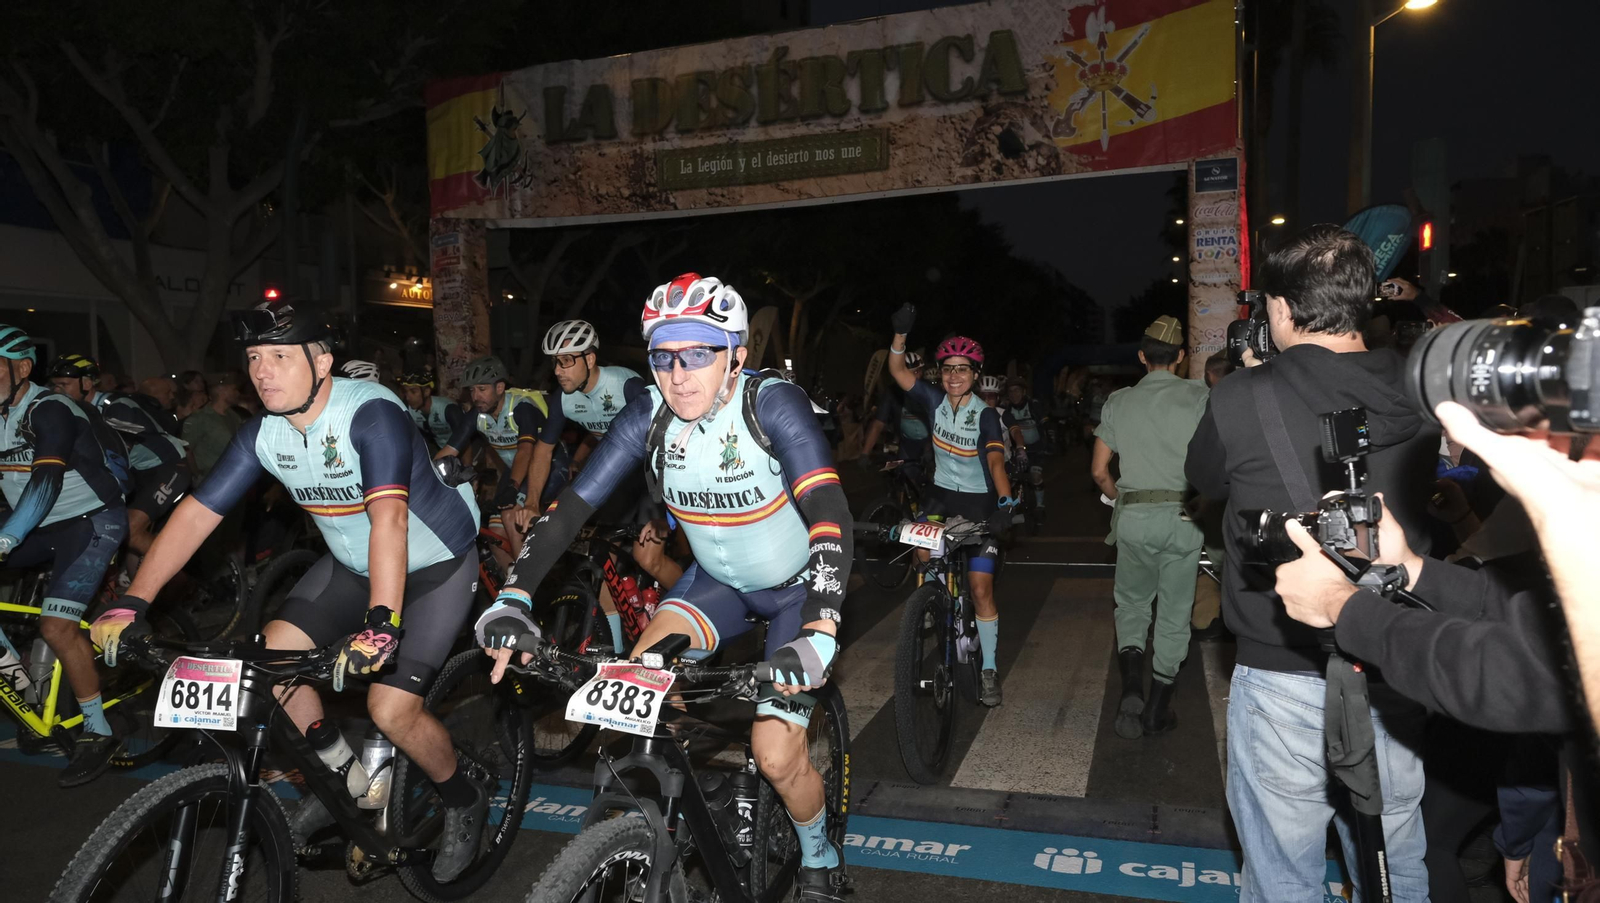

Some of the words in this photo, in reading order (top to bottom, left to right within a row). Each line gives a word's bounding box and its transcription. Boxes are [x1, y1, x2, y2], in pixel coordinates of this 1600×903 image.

[543, 84, 616, 144] LA
[631, 29, 1027, 137] DESÉRTICA
[680, 159, 693, 175] La
[698, 155, 732, 175] Legión
[738, 159, 747, 174] y
[751, 153, 762, 169] el
[767, 148, 809, 168] desierto
[815, 147, 836, 161] nos
[841, 145, 862, 159] une
[1196, 228, 1236, 236] GRUPO
[1196, 236, 1236, 247] RENTA
[330, 469, 354, 480] EDICIÓN
[715, 476, 723, 484] VI
[724, 470, 755, 483] EDICIÓN
[295, 482, 364, 502] DESÉRTICA
[677, 486, 766, 510] DESÉRTICA
[909, 523, 940, 539] 7201
[47, 603, 59, 612] LA
[171, 680, 232, 711] 6814
[586, 680, 655, 719] 8383
[184, 715, 222, 725] cajamar
[598, 717, 639, 729] cajamar
[841, 753, 850, 813] MAXXIS
[547, 814, 581, 824] CAJA
[495, 832, 504, 845] DT
[501, 814, 513, 834] SWISS
[860, 848, 900, 859] CAJA
[906, 852, 960, 866] RURAL
[1376, 850, 1391, 897] Manfrotto
